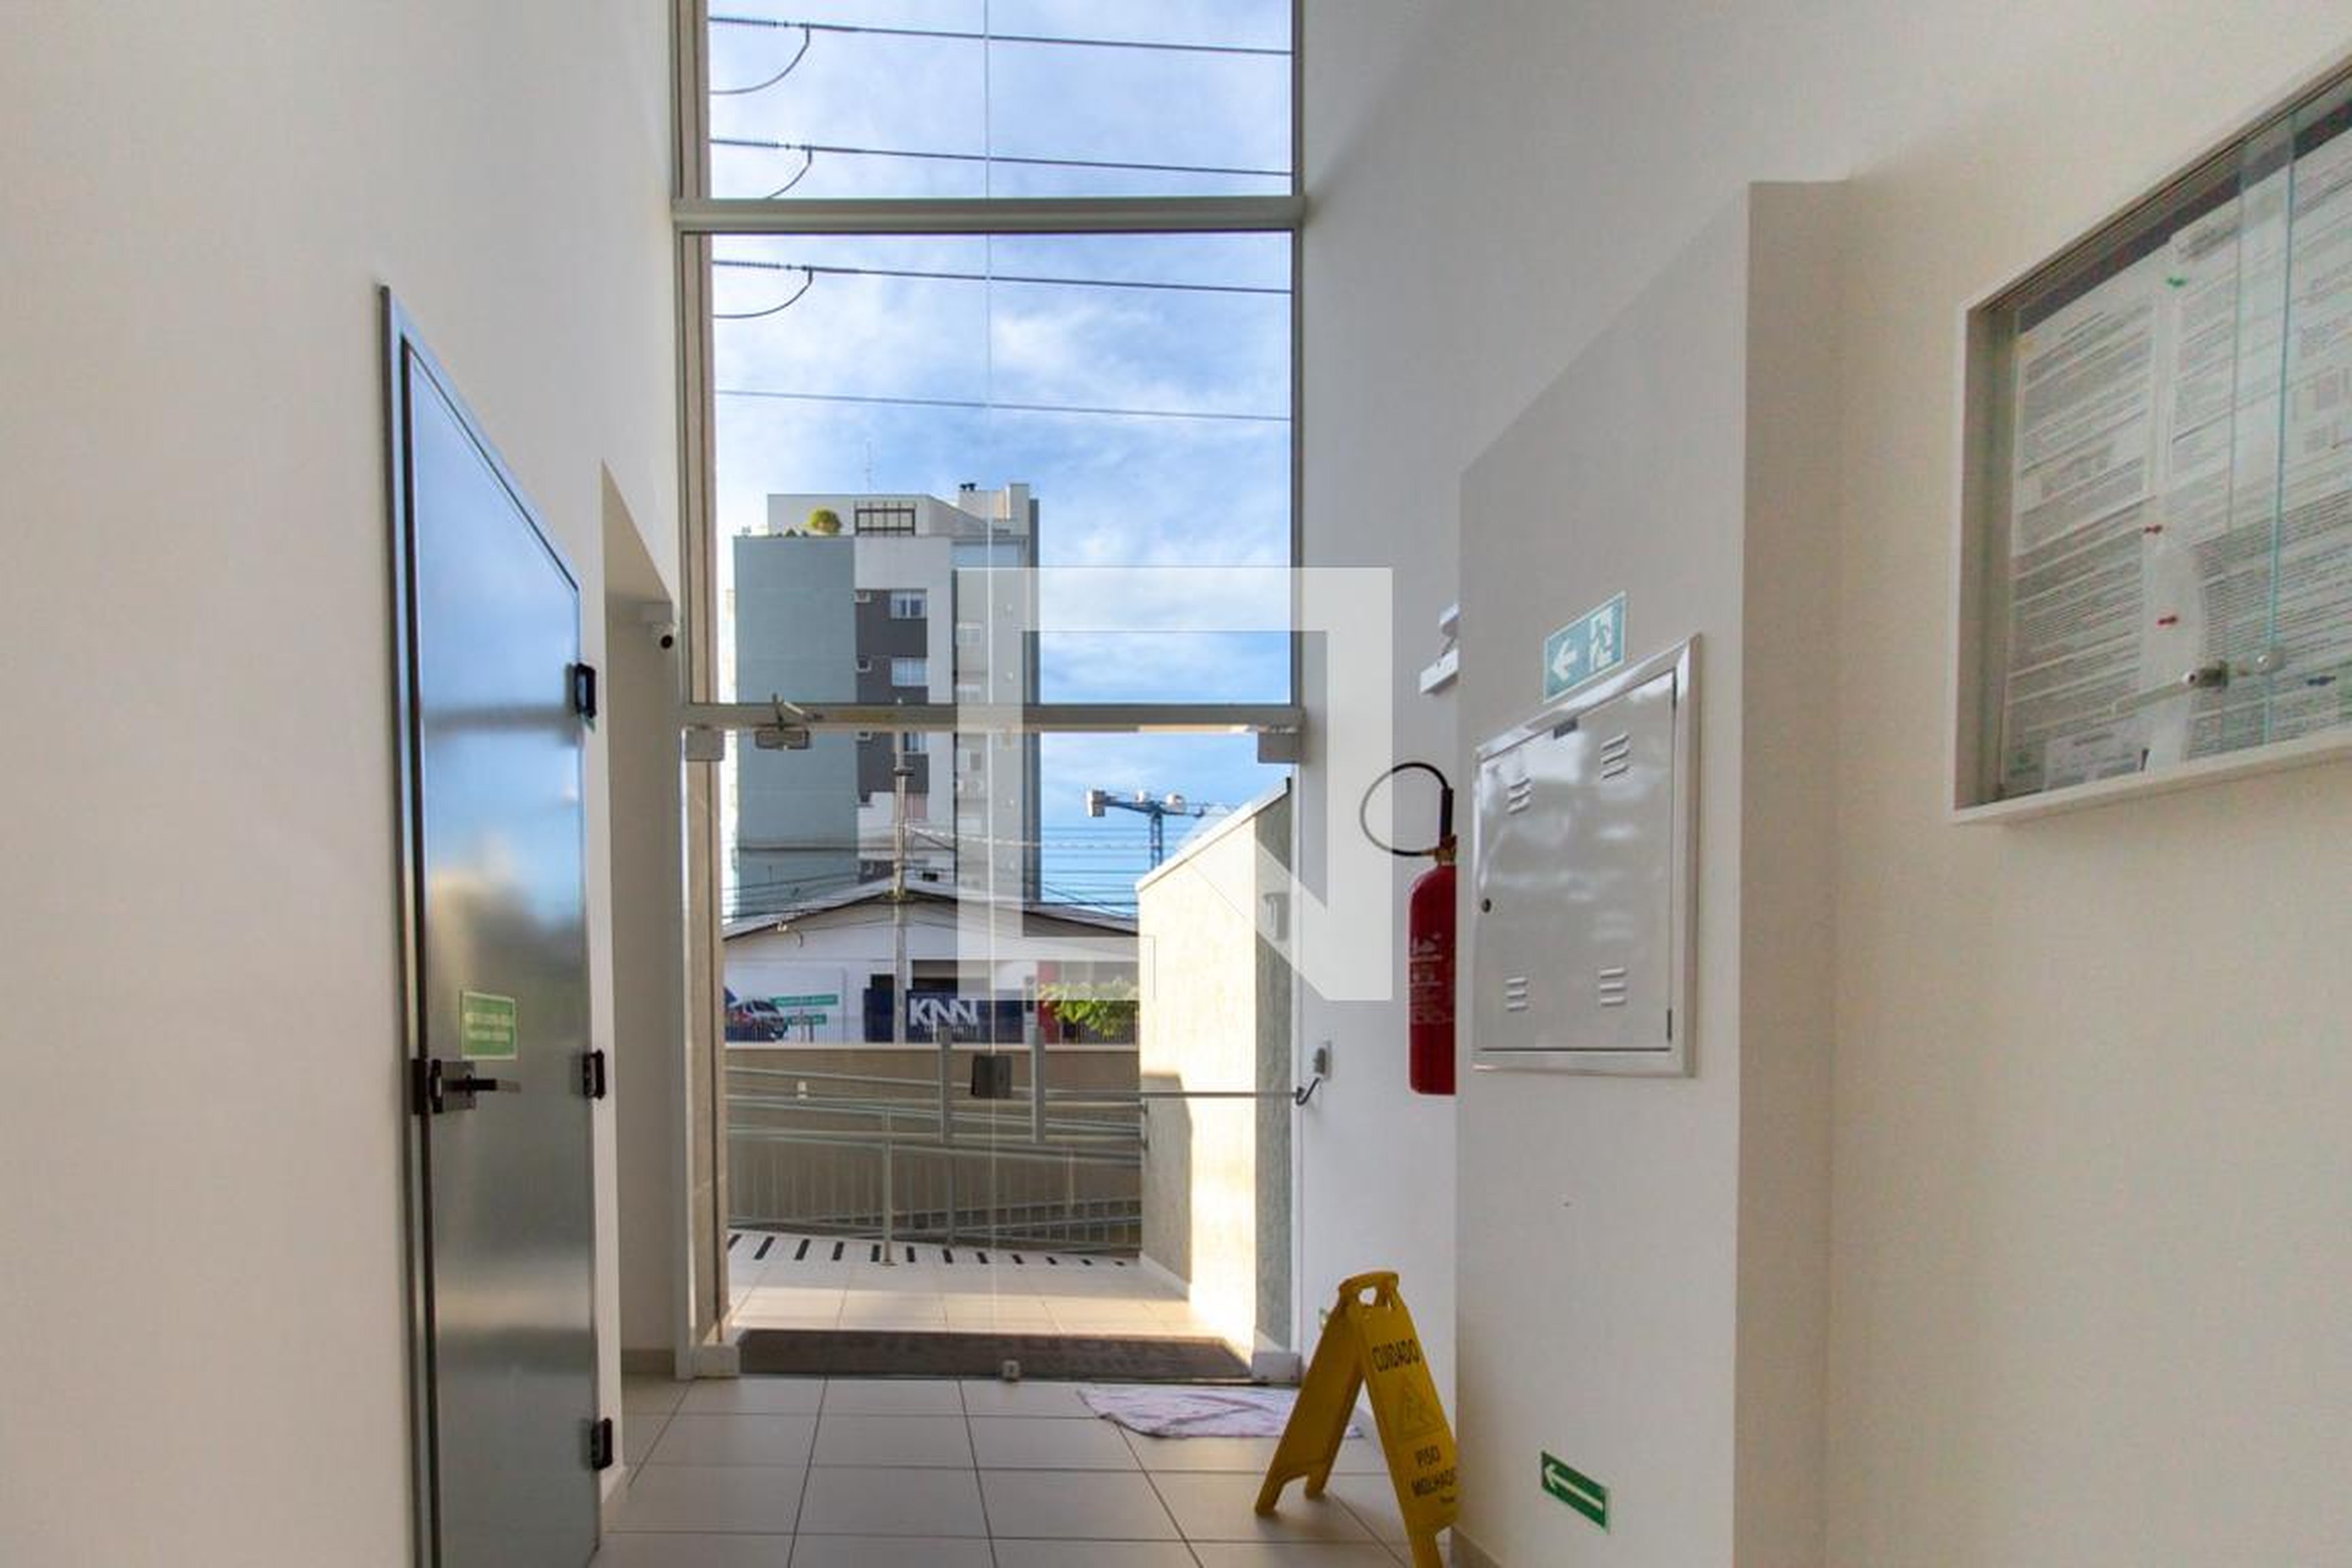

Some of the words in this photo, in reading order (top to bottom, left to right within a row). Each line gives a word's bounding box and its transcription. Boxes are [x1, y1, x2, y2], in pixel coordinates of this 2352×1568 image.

[910, 998, 978, 1026] KNN
[1372, 1338, 1419, 1372] CUIDADO
[1415, 1446, 1441, 1466] PISO
